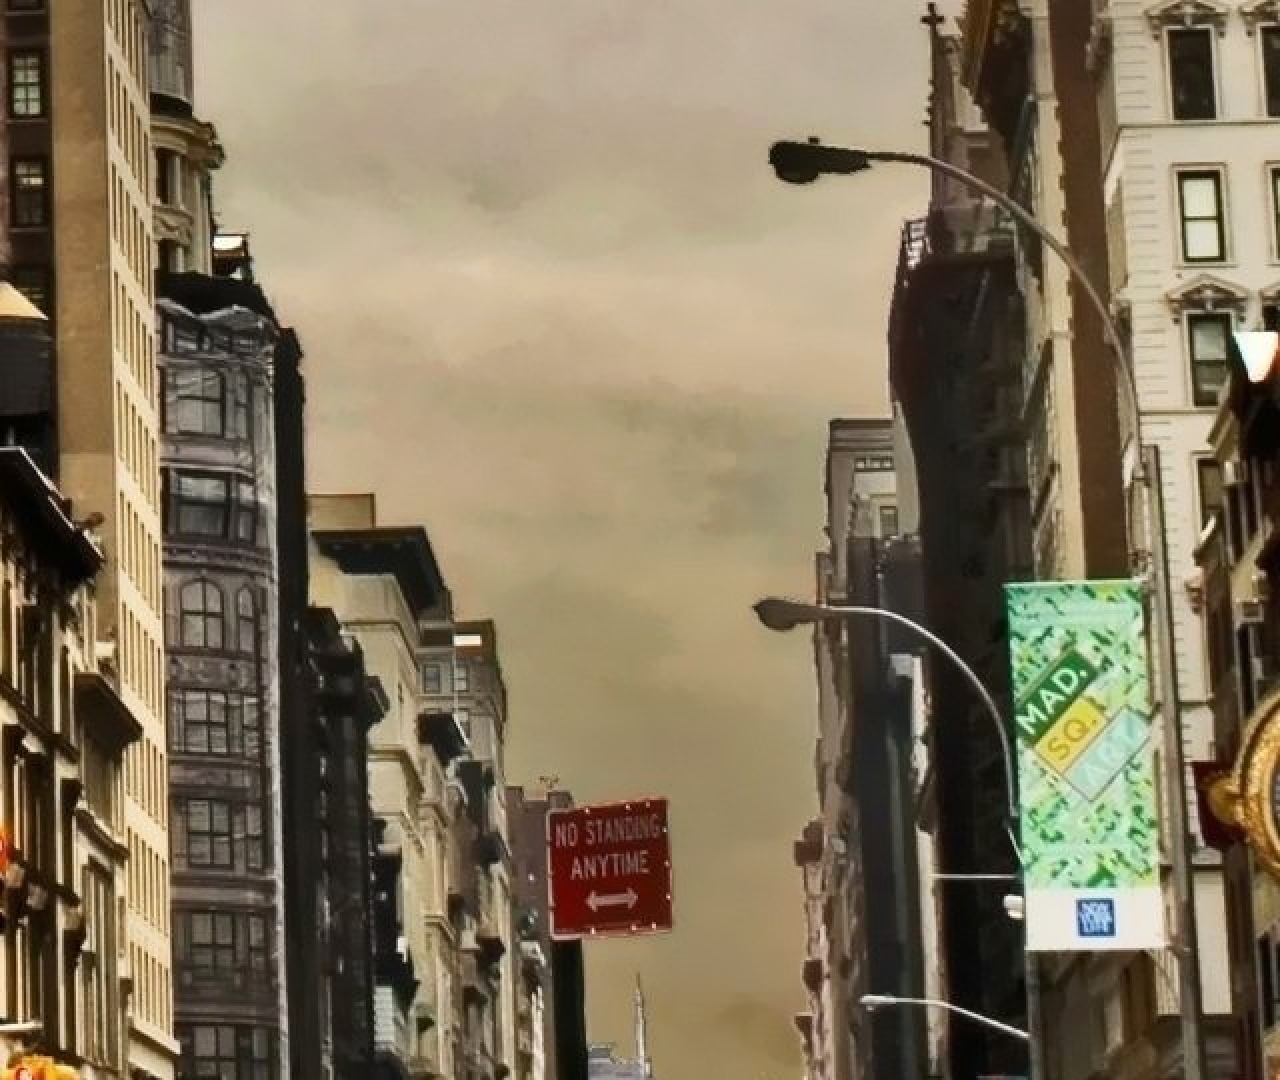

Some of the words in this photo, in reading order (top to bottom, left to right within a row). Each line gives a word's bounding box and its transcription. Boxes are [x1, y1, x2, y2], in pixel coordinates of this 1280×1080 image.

[1016, 668, 1087, 735] MAD.
[1048, 718, 1097, 760] SQ.
[555, 821, 579, 847] NO
[585, 814, 660, 845] STANDING
[571, 850, 650, 880] ANYTIME
